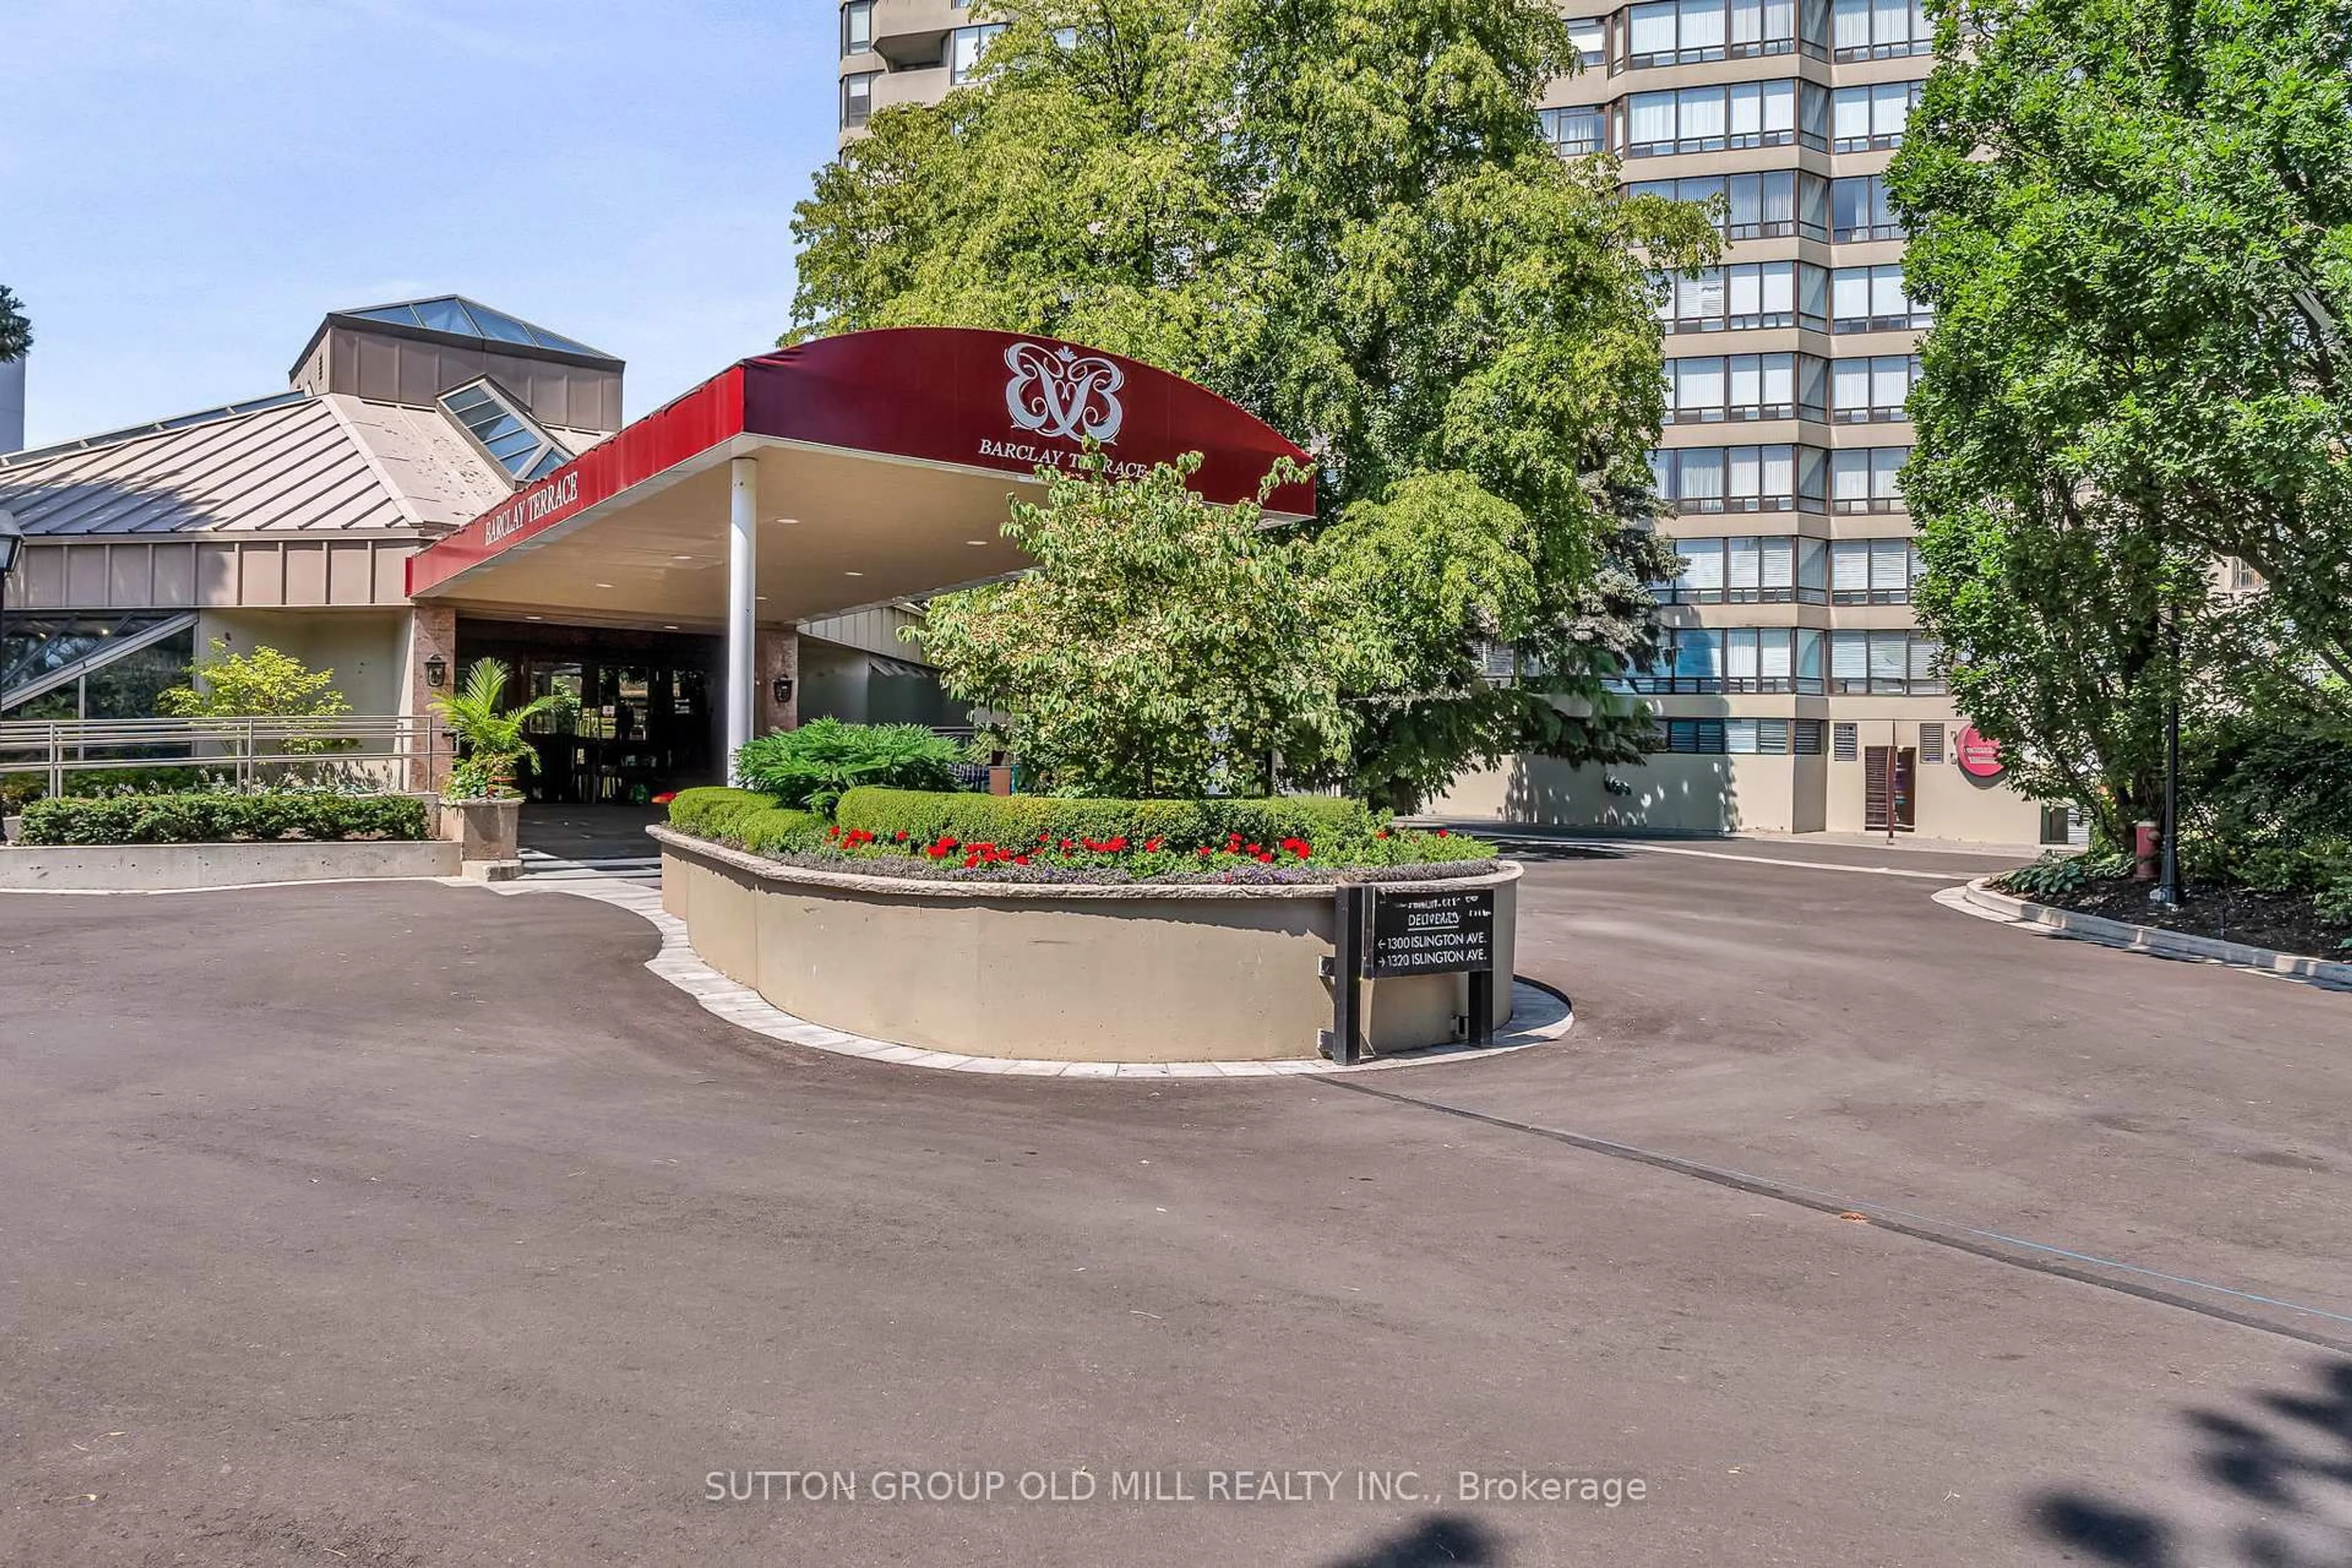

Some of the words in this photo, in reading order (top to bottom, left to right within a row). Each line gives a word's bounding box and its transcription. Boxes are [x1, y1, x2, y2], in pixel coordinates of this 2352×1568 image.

[979, 439, 1064, 466] BARCLAY
[1069, 453, 1147, 478] TRACE
[486, 500, 526, 545] BARCLAY
[528, 472, 578, 522] TERRACE
[1387, 937, 1409, 949] 1300
[1411, 933, 1463, 948] ISLINGTON
[1466, 932, 1487, 944] AVE.
[1387, 954, 1409, 967] 1320
[1412, 951, 1464, 965] ISLINGTON
[1466, 948, 1487, 961] AVE.
